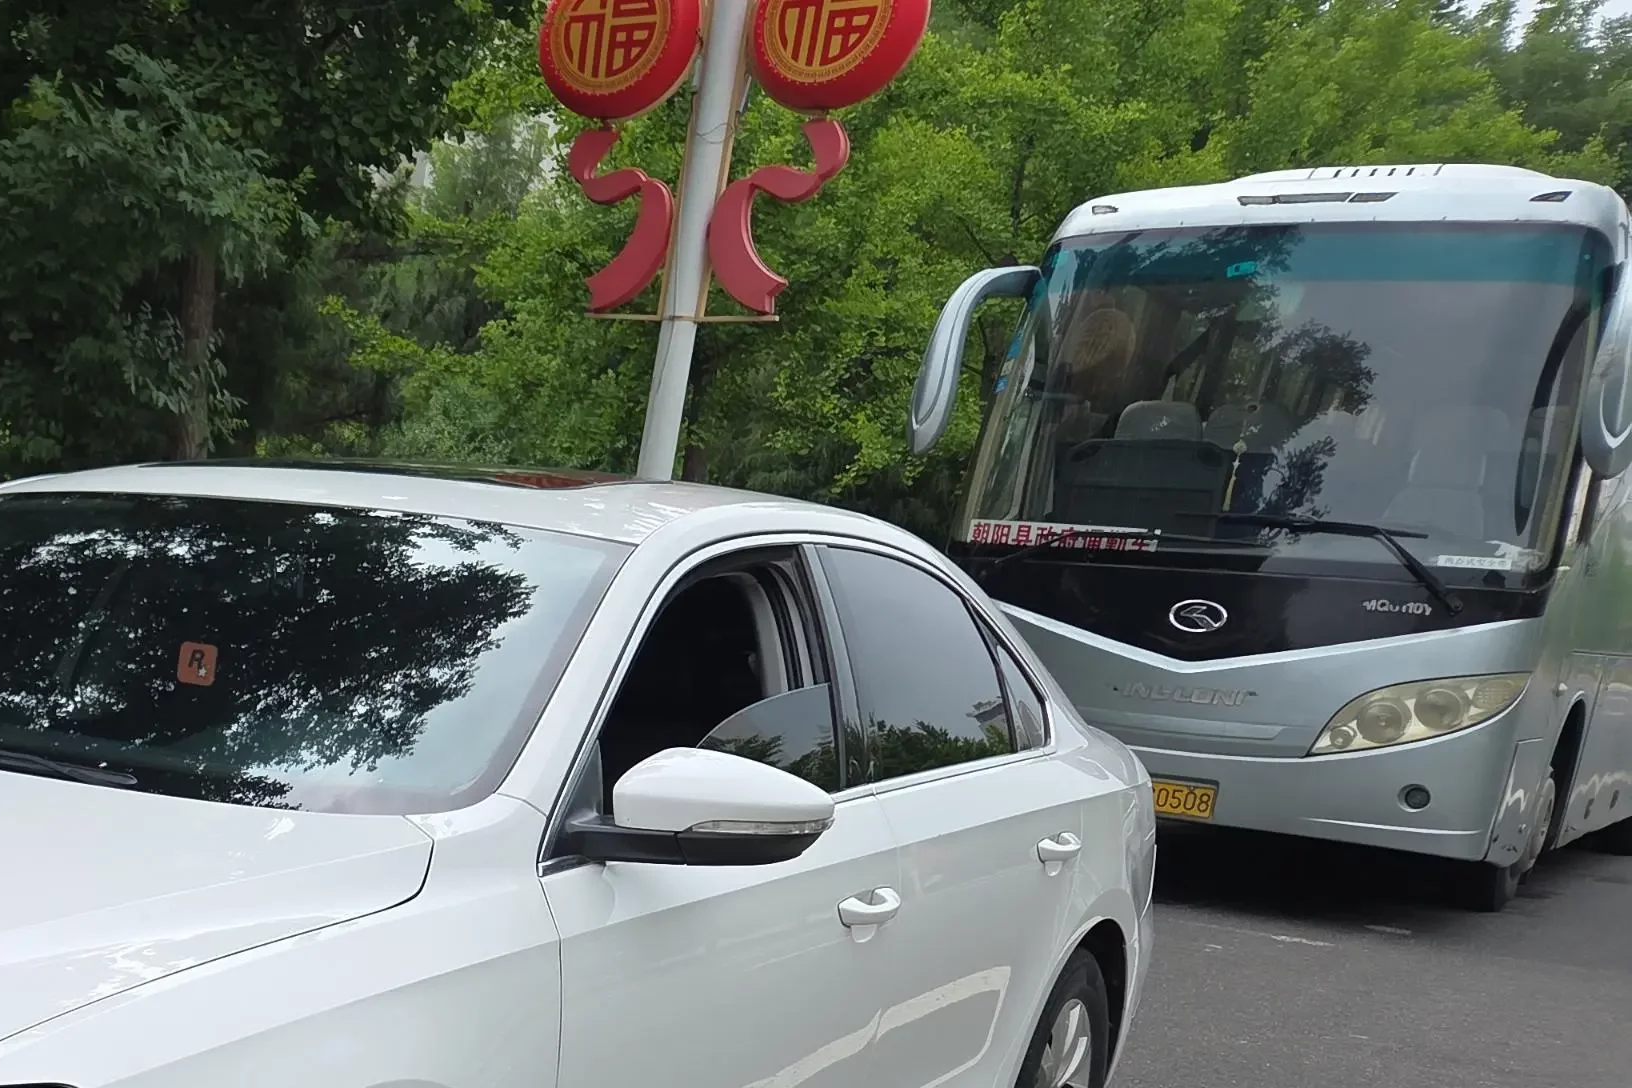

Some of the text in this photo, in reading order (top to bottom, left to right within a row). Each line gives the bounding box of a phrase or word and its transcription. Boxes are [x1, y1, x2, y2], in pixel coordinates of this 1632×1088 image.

[564, 0, 658, 79] 福
[778, 0, 879, 67] 福
[1152, 786, 1211, 814] 0508
